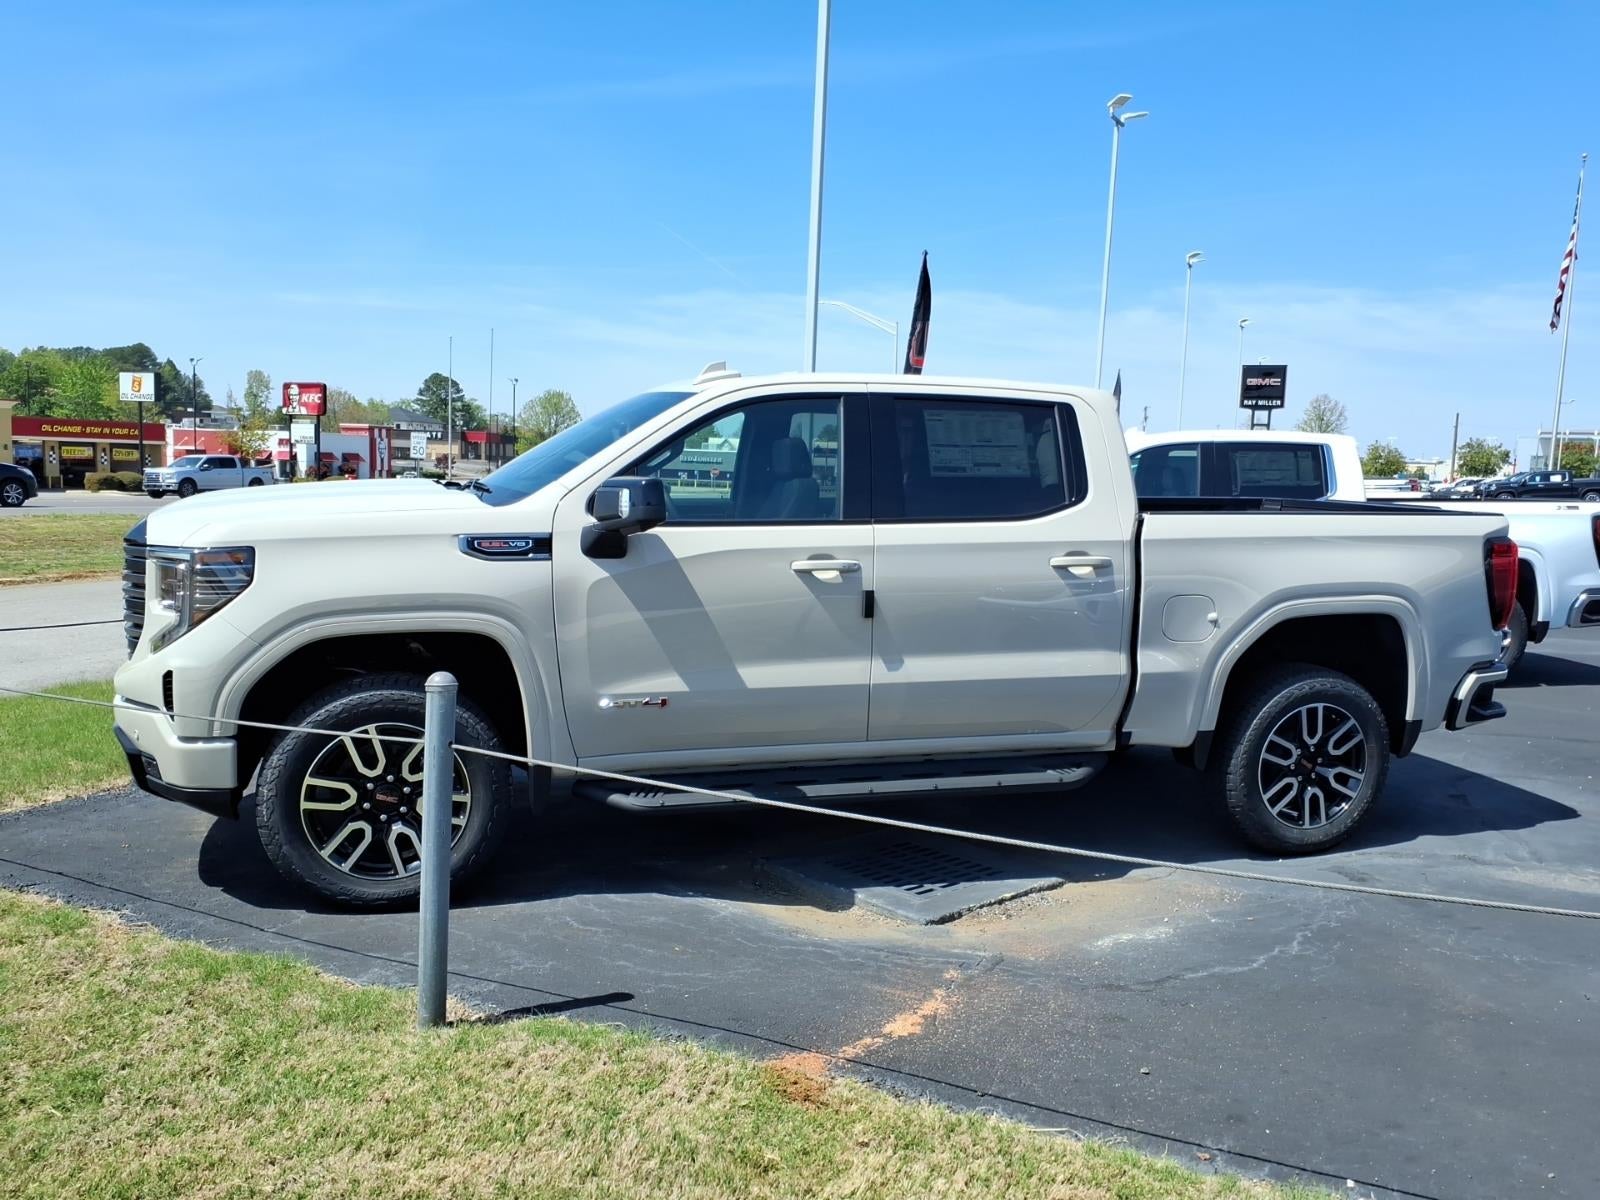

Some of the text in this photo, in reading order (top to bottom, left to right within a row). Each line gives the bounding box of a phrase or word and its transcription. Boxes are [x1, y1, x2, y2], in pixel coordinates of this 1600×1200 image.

[1246, 378, 1281, 386] GMC
[301, 393, 321, 403] KFC
[41, 424, 52, 432] OIL
[53, 425, 81, 433] CHANGE
[412, 445, 425, 456] 50
